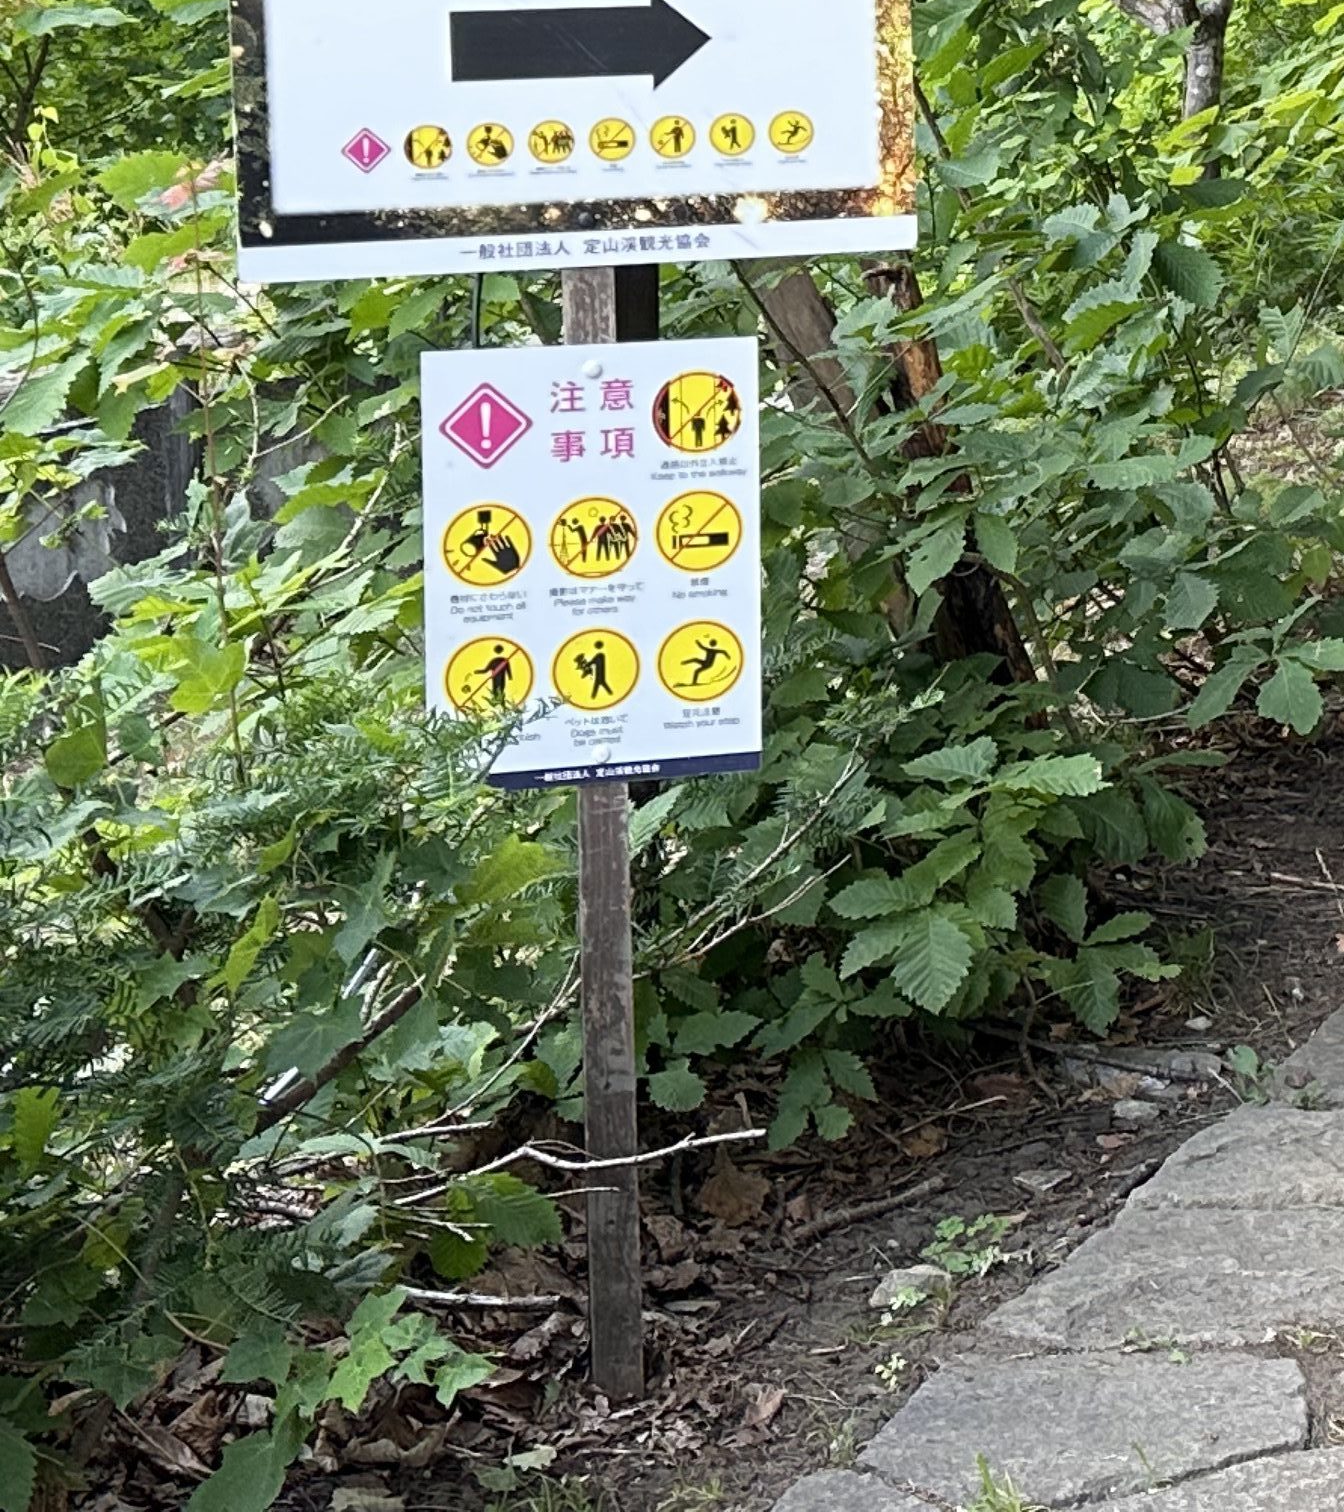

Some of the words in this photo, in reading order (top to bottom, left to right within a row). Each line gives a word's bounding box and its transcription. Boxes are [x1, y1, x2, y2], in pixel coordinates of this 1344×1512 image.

[460, 241, 571, 260] 一般社団法人
[583, 233, 711, 255] 定山渓観光協会
[549, 377, 635, 414] 注意
[549, 425, 636, 463] 事項
[450, 605, 465, 614] Do
